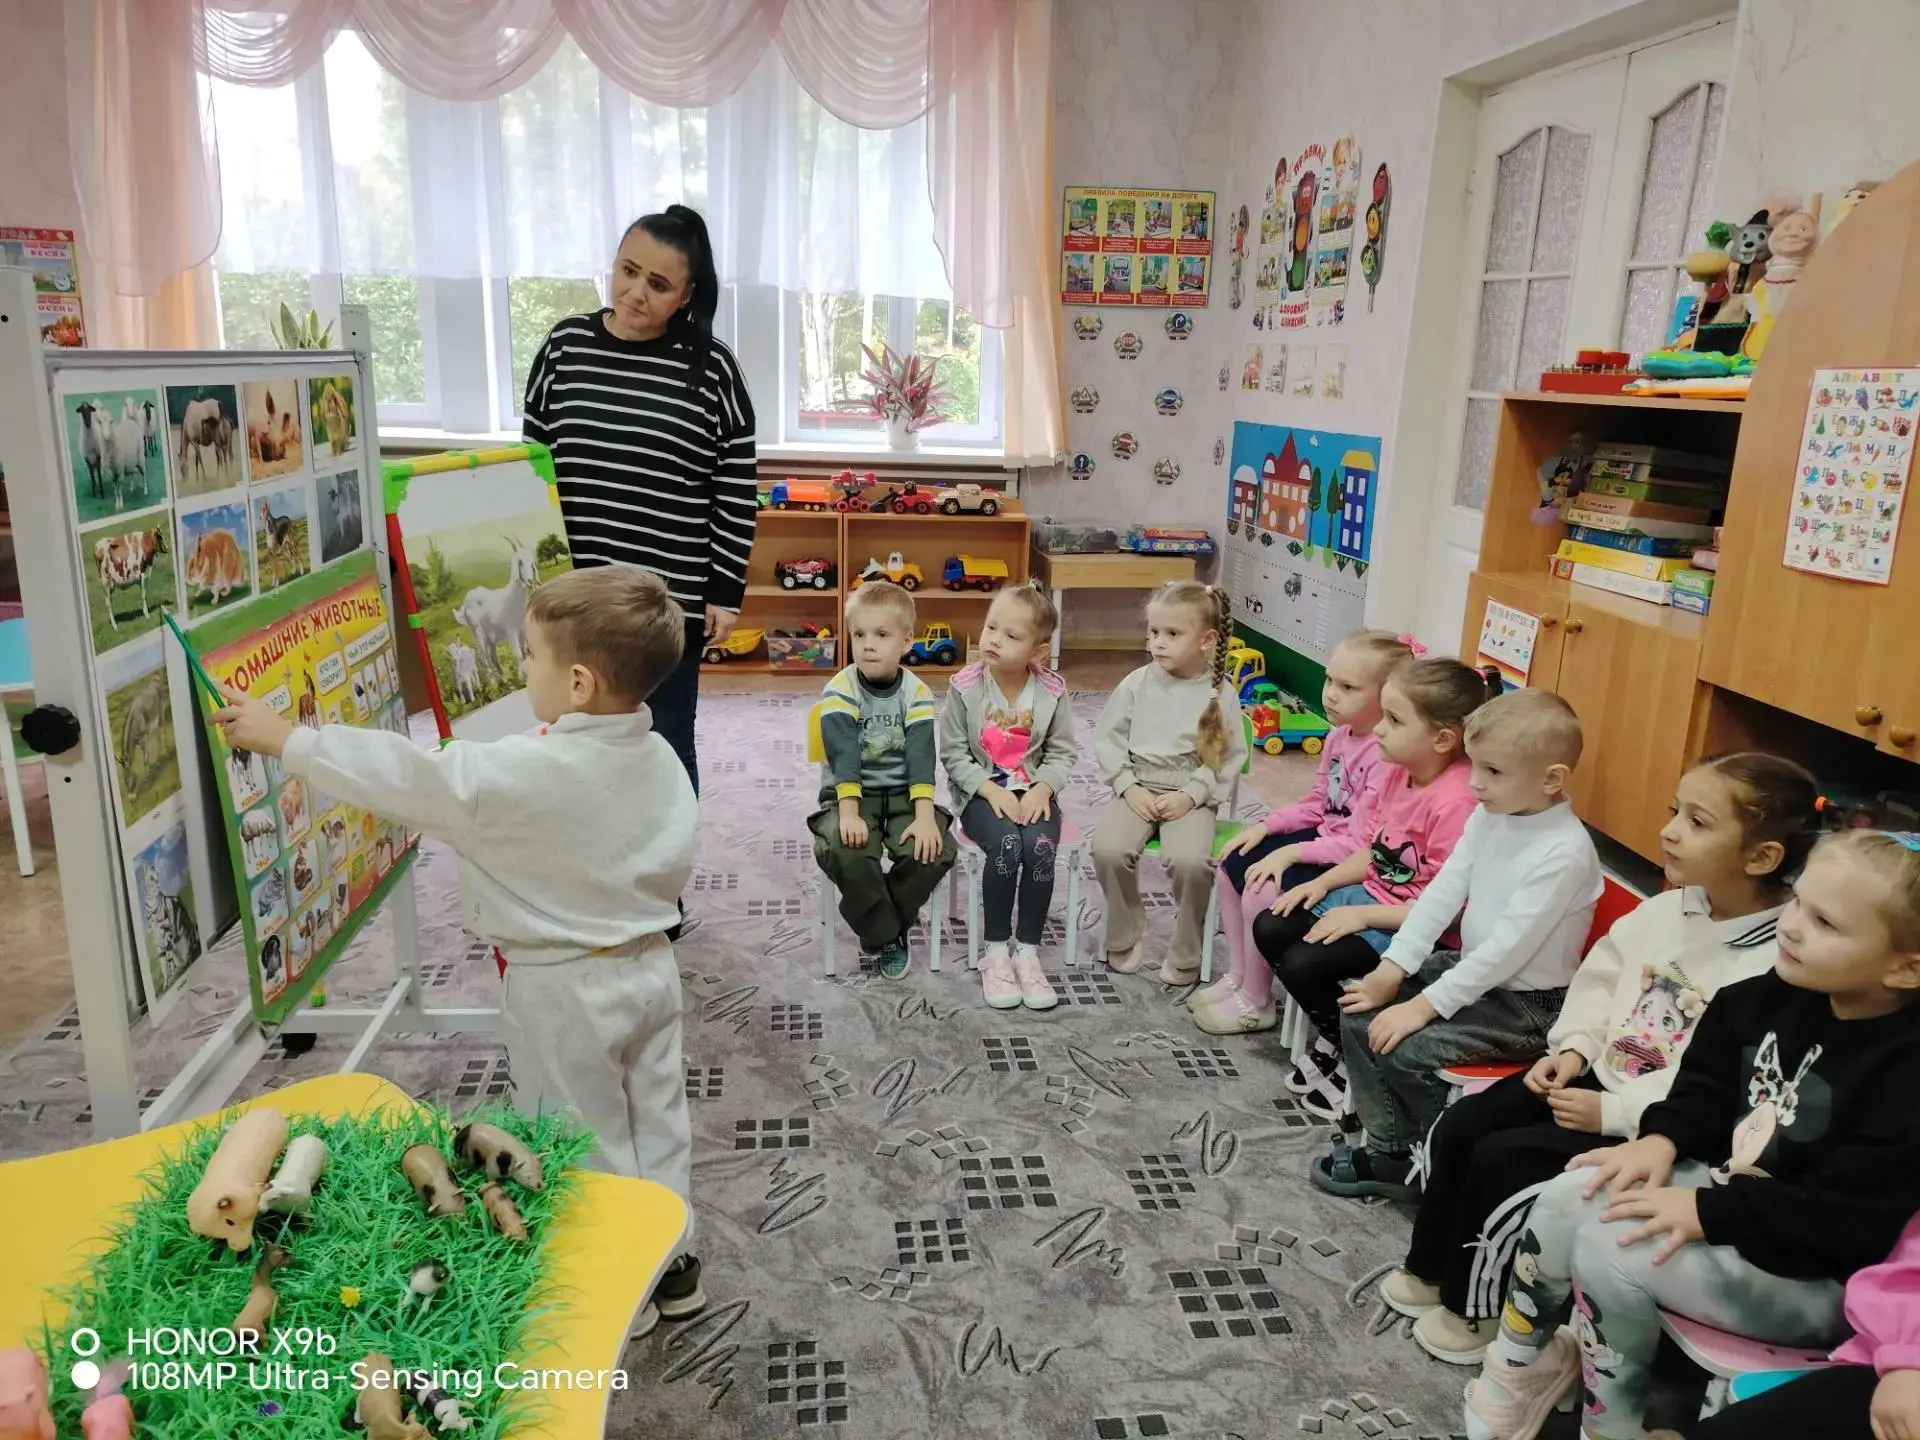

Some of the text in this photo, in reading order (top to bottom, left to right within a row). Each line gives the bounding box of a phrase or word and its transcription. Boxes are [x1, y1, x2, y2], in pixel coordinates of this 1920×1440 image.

[1119, 190, 1160, 198] ПОВЕДЕНИЯ
[1172, 192, 1199, 200] ДОРОГЕ
[309, 598, 381, 632] ЖИВОТНЫЕ
